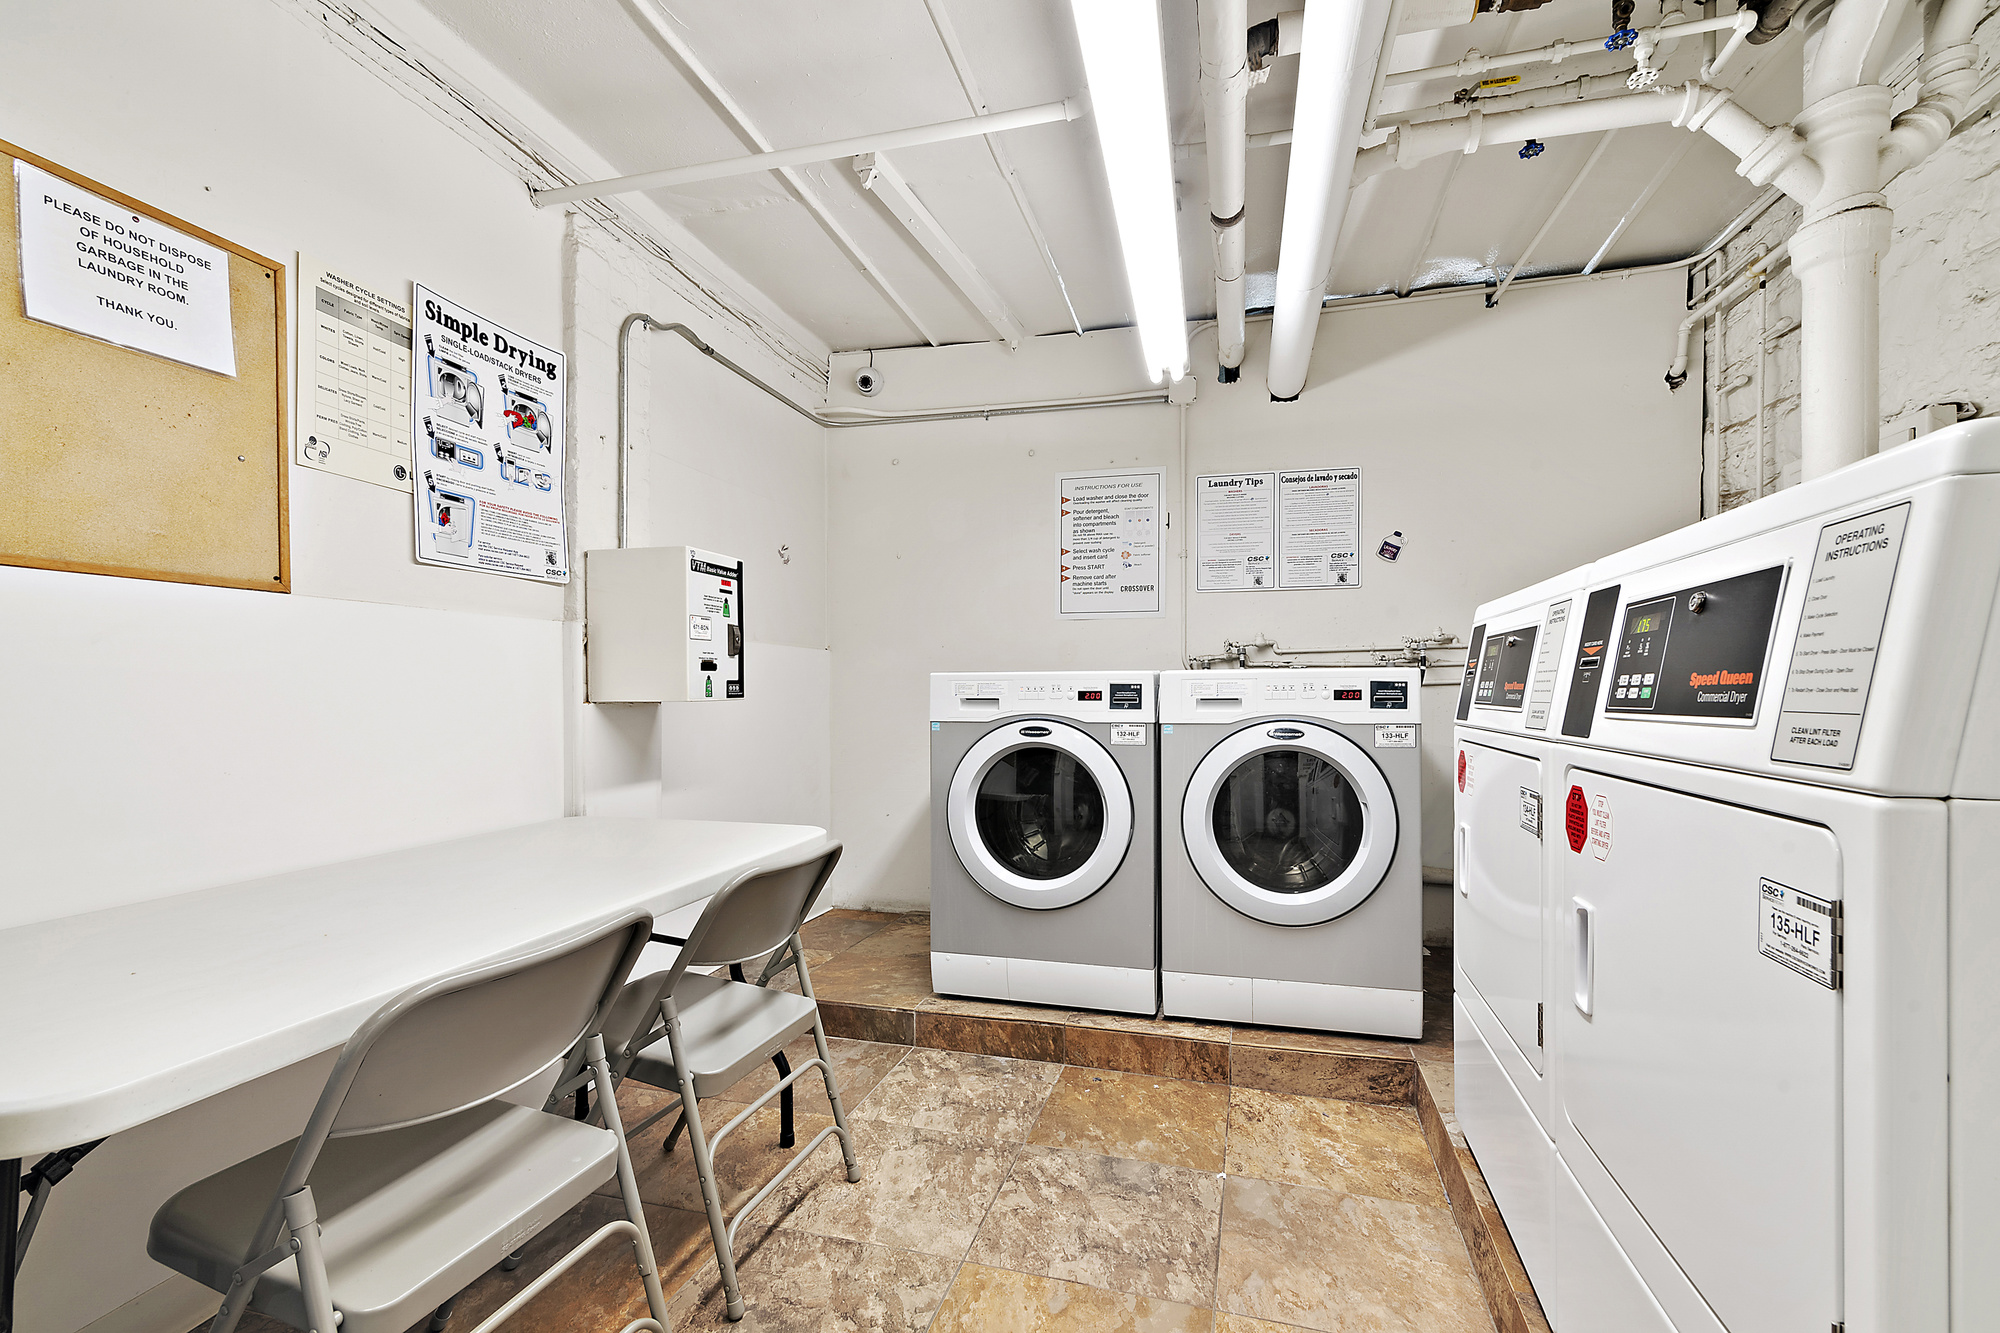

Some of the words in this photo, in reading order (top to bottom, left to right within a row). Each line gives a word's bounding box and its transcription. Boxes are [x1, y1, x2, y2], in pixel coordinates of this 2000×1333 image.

[44, 195, 101, 227] PLEASE
[105, 220, 124, 235] DO
[129, 229, 155, 248] NOT
[159, 242, 212, 271] DISPOSE
[80, 226, 99, 240] OF
[103, 235, 184, 274] HOUSEHOLD
[76, 241, 145, 274] GARBAGE
[149, 268, 161, 280] IN
[164, 274, 189, 291] THE
[78, 258, 144, 288] LAUNDRY
[147, 282, 189, 305] ROOM.
[326, 271, 354, 289] WASHER
[355, 286, 376, 299] CYCLE
[377, 296, 405, 313] SETTINGS
[321, 298, 335, 308] CYCLE
[97, 295, 143, 319] THANK
[147, 312, 178, 330] YOU.
[425, 299, 489, 348] Simple
[493, 332, 557, 381] Drying
[428, 342, 433, 350] 1
[319, 354, 335, 364] COLORS
[441, 334, 514, 373] SINGLE-LOAD/STACK
[514, 367, 542, 385] DRYERS
[427, 424, 433, 432] 3
[1208, 478, 1243, 488] Laundry
[1245, 478, 1264, 487] Tips
[1281, 475, 1306, 484] Consejos
[1307, 474, 1314, 482] de
[1315, 473, 1333, 482] lavado
[1334, 474, 1338, 482] y
[1338, 472, 1358, 480] secado
[1074, 483, 1116, 491] INSTRUCTIONS
[1835, 523, 1885, 545] OPERATING
[1825, 537, 1889, 562] INSTRUCTIONS
[545, 568, 562, 576] CSC
[1689, 670, 1720, 689] Speed
[1720, 670, 1753, 685] Queen
[1341, 691, 1360, 699] 2.00
[1697, 690, 1731, 702] Commercial
[1730, 691, 1748, 705] Dryer
[1791, 727, 1808, 735] CLEAN
[1822, 729, 1841, 737] FILTER
[1789, 736, 1806, 744] AFTER
[1807, 738, 1822, 746] EACH
[1822, 739, 1839, 747] LOAD
[1762, 884, 1779, 897] CSC
[1771, 912, 1820, 947] 135-HLF
